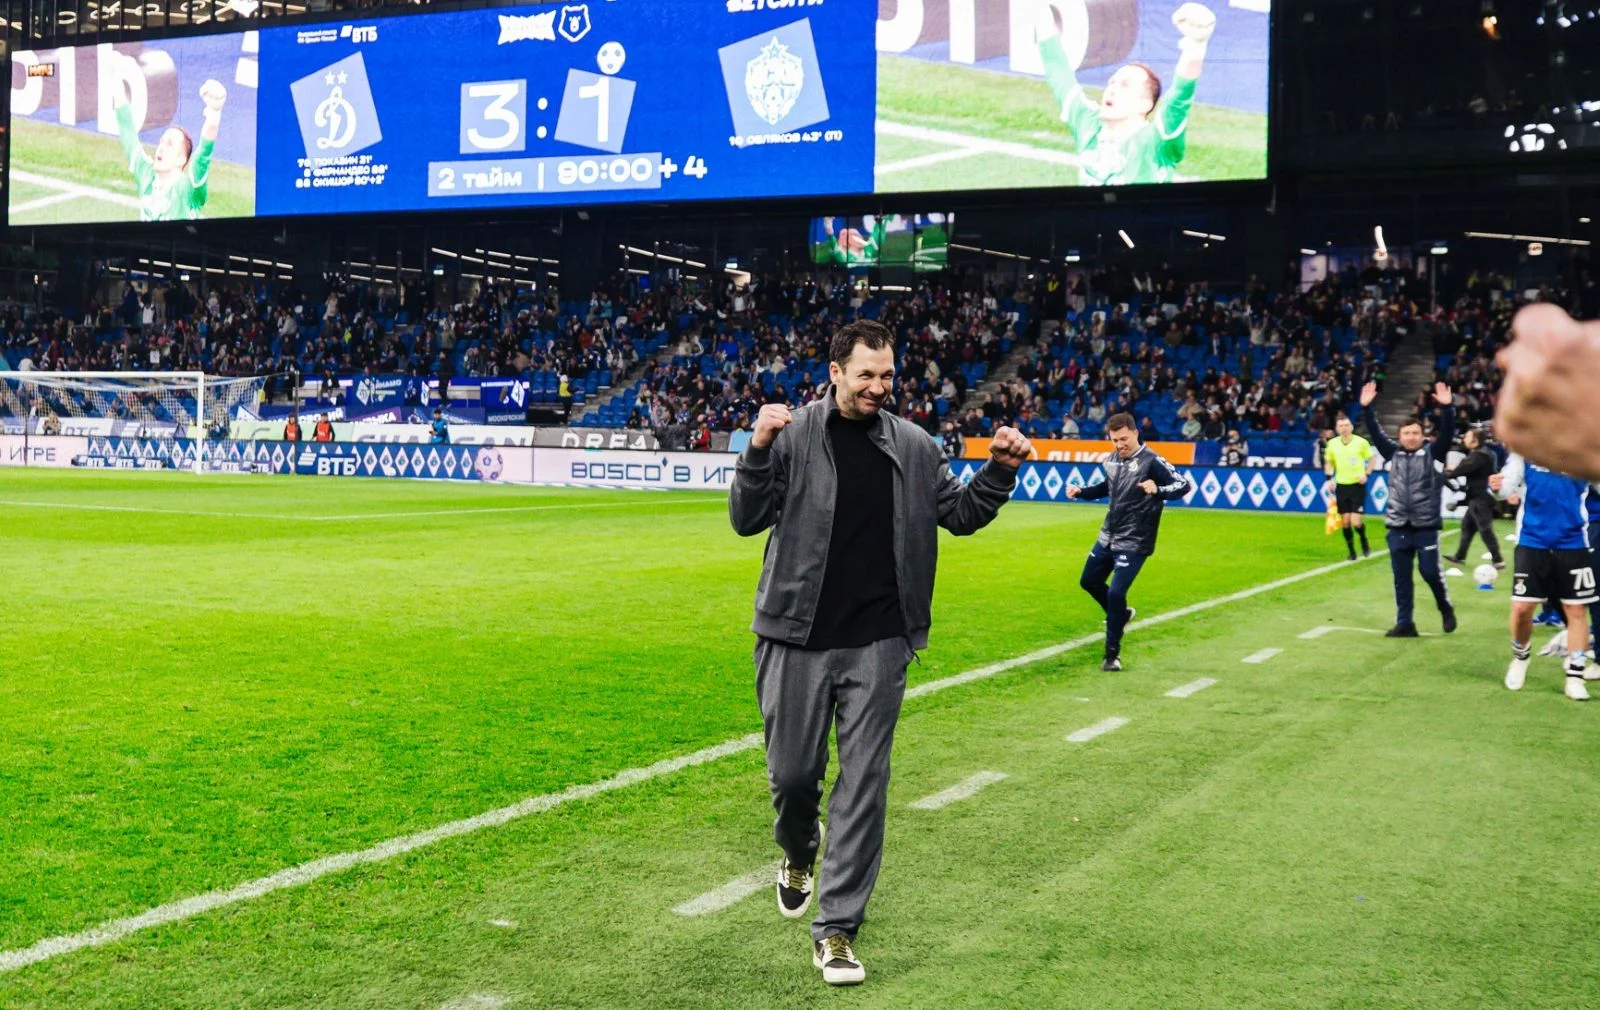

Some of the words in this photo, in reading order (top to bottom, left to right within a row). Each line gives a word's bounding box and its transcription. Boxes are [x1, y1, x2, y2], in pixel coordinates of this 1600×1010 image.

[352, 26, 378, 43] ВТБ
[467, 83, 520, 150] 3
[578, 75, 610, 143] 1
[437, 167, 456, 190] 2
[462, 166, 523, 188] тайм
[557, 156, 653, 185] 90:00
[561, 432, 661, 450] DREA
[9, 446, 57, 462] ИГРЕ
[317, 457, 357, 476] ВТБ
[1569, 567, 1596, 590] 70
